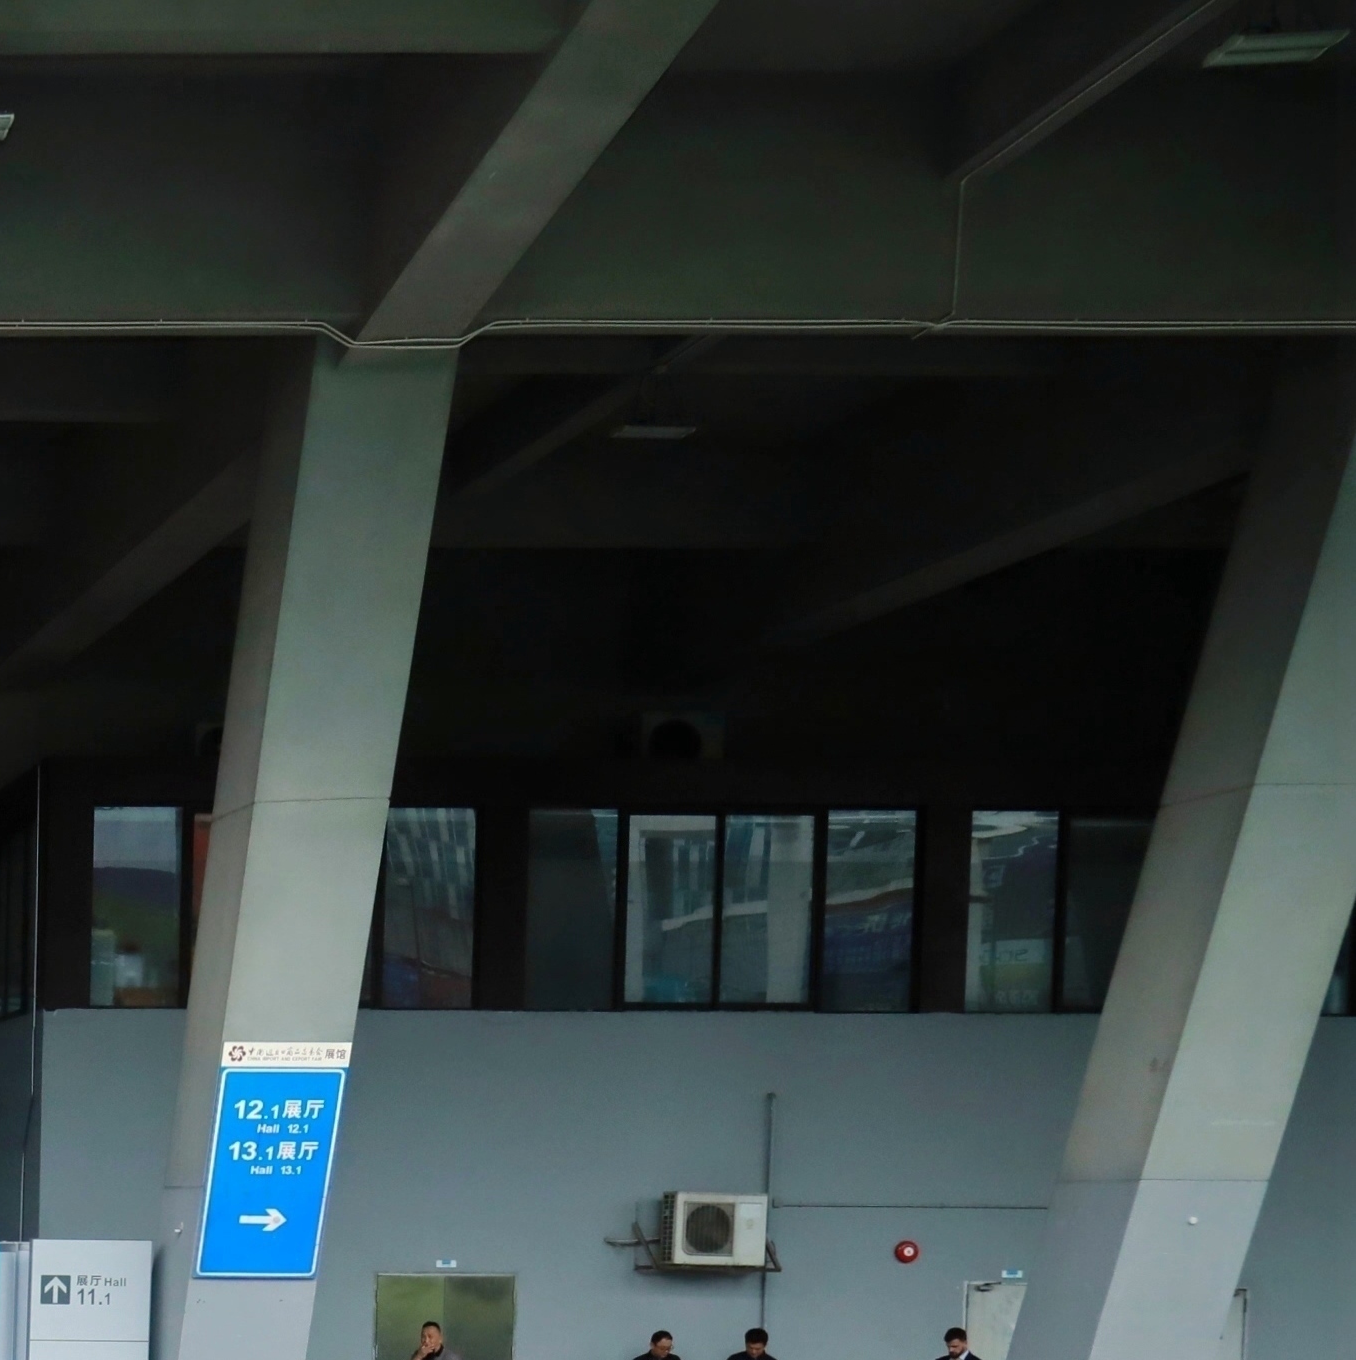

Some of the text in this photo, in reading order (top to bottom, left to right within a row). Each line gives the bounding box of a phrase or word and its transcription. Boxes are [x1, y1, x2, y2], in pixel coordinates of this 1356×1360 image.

[324, 1048, 347, 1060] 展馆
[256, 1124, 309, 1133] Hall 12.1
[250, 1166, 302, 1175] Hall 13.1
[76, 1275, 127, 1287] 展厅 Hall
[77, 1288, 111, 1305] 11.1
